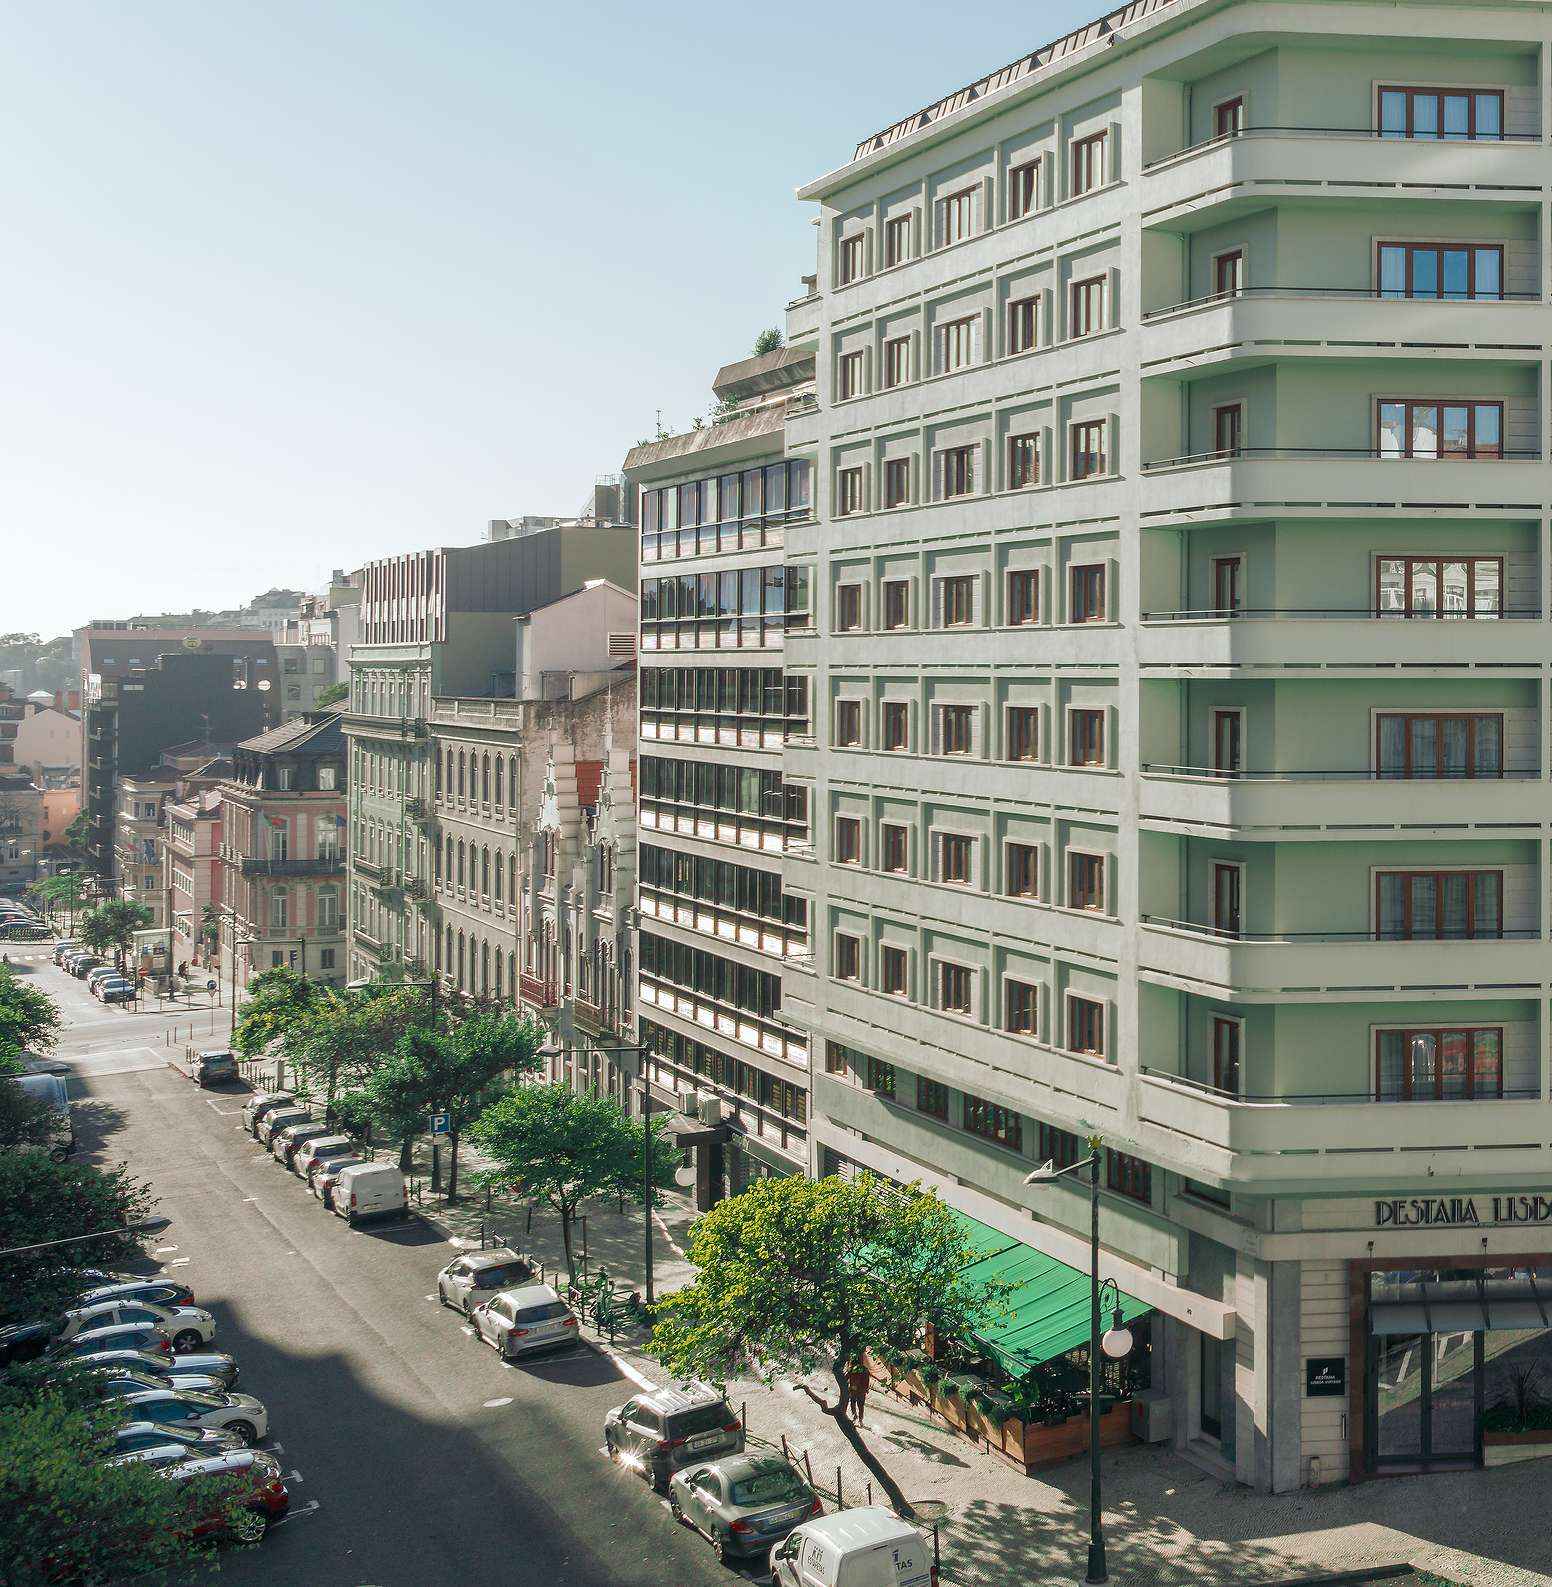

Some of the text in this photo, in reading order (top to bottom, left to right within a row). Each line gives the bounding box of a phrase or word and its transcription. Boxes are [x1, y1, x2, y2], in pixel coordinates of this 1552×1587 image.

[434, 1117, 446, 1131] P
[1376, 1198, 1479, 1225] PESTANA
[895, 1558, 913, 1571] TAS
